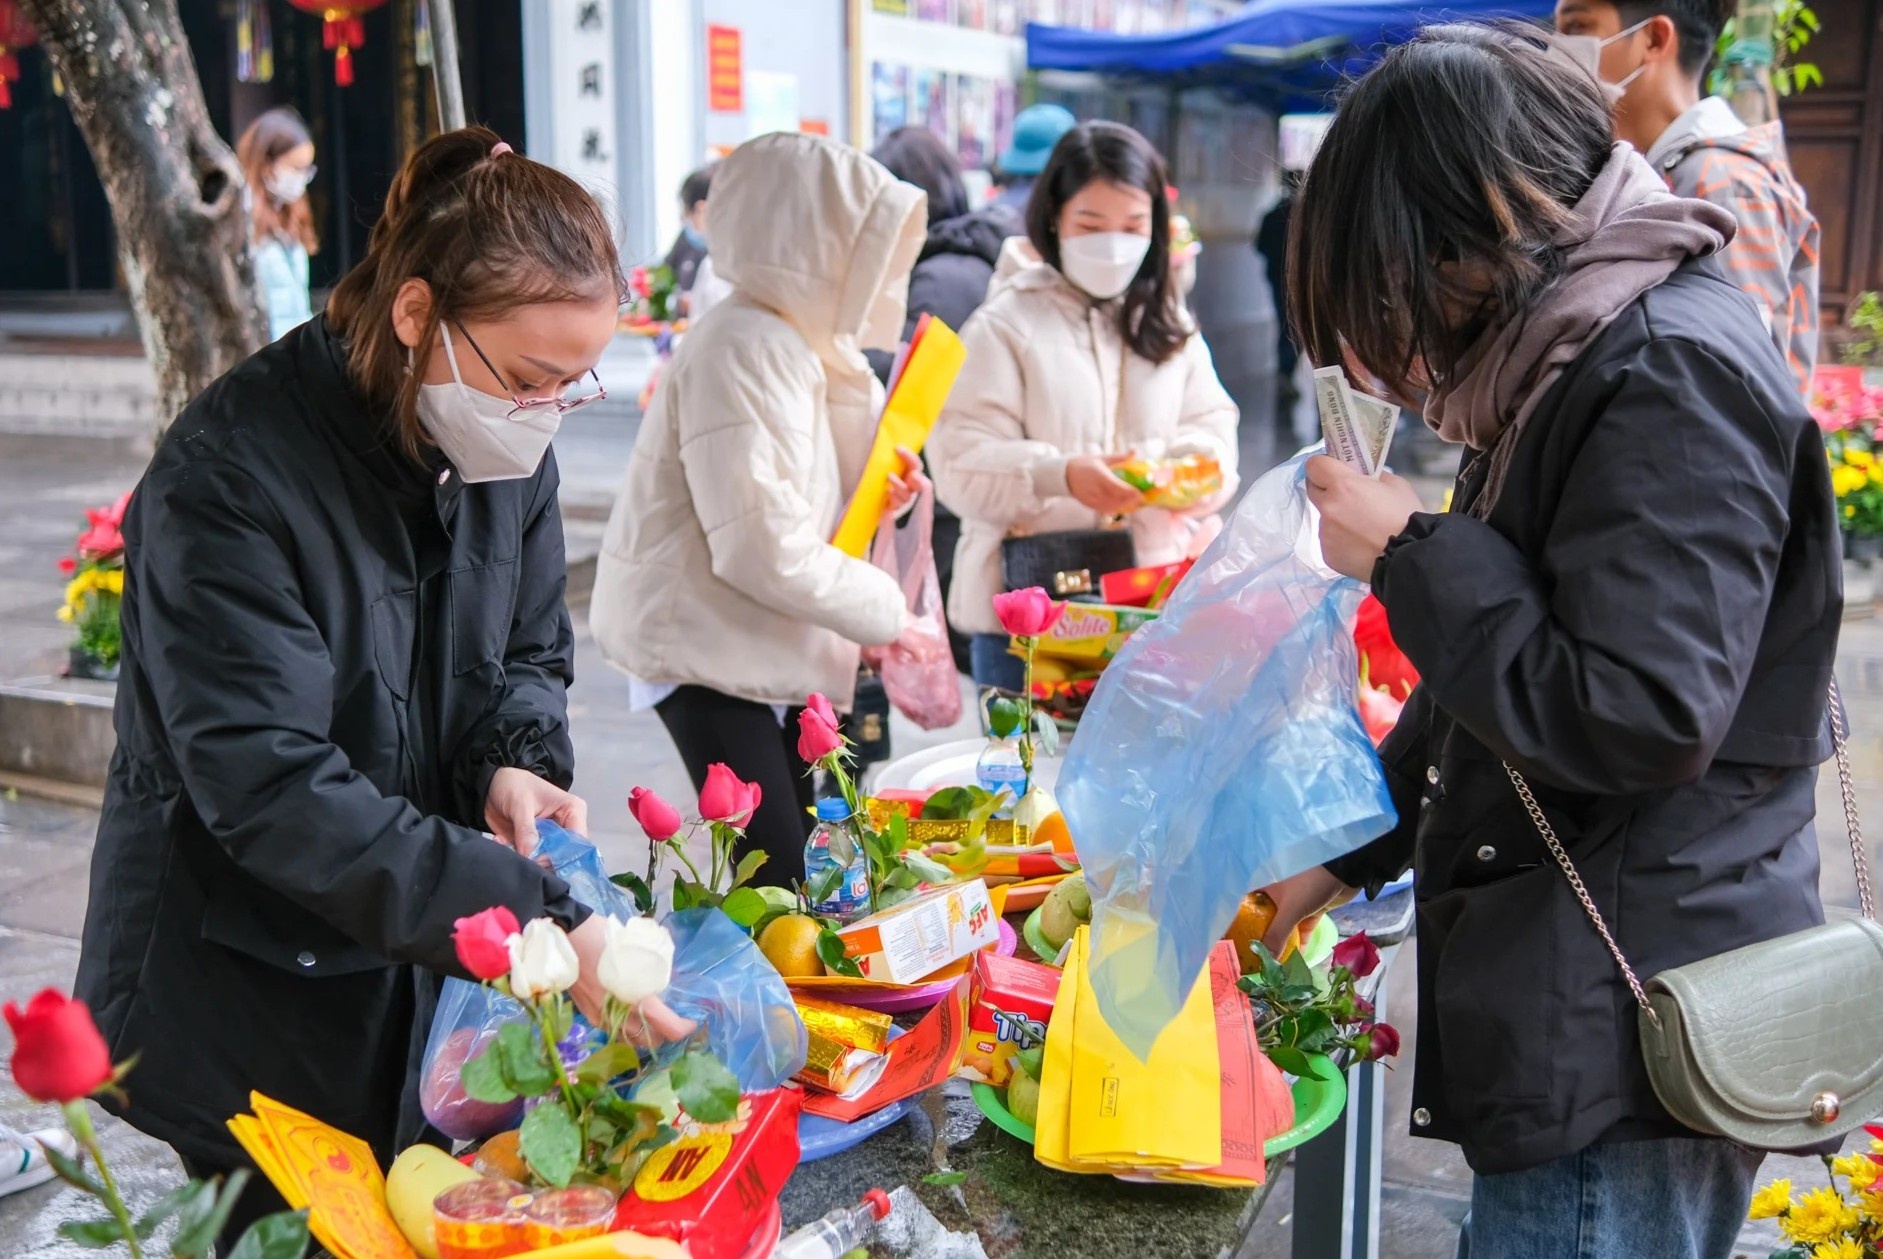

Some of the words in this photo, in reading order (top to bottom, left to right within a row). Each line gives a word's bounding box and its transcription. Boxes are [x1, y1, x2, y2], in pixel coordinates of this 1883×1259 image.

[1053, 613, 1111, 639] Solite
[968, 903, 989, 936] AFC
[656, 1145, 712, 1182] AN
[736, 1157, 767, 1211] AN
